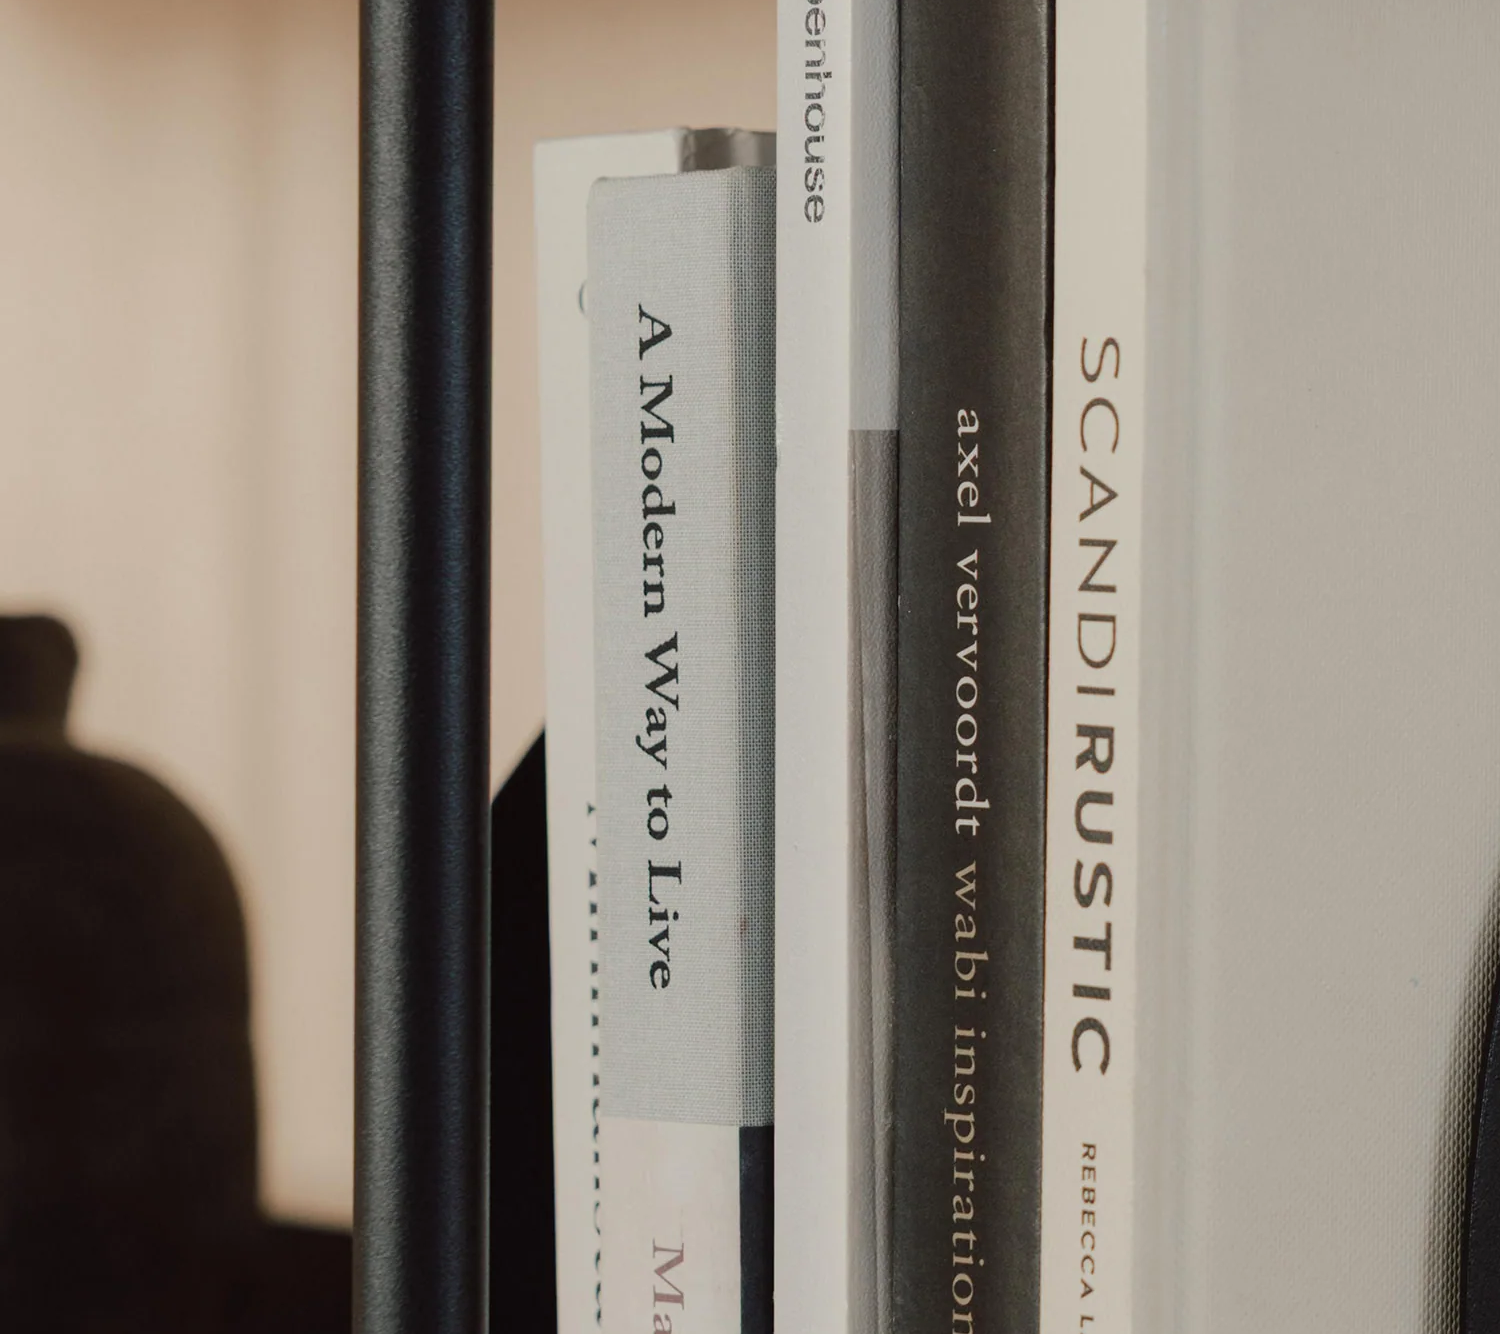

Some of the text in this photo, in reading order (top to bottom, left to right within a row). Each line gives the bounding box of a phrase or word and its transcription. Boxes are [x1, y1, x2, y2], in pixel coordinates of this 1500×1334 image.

[956, 408, 992, 527] axel
[635, 302, 683, 990] A Modern Way to Live
[954, 548, 991, 837] vervoordt
[1070, 336, 1121, 1076] SCANDIRUSTIC
[954, 860, 989, 1000] wabi
[1080, 1142, 1097, 1299] REBECCA
